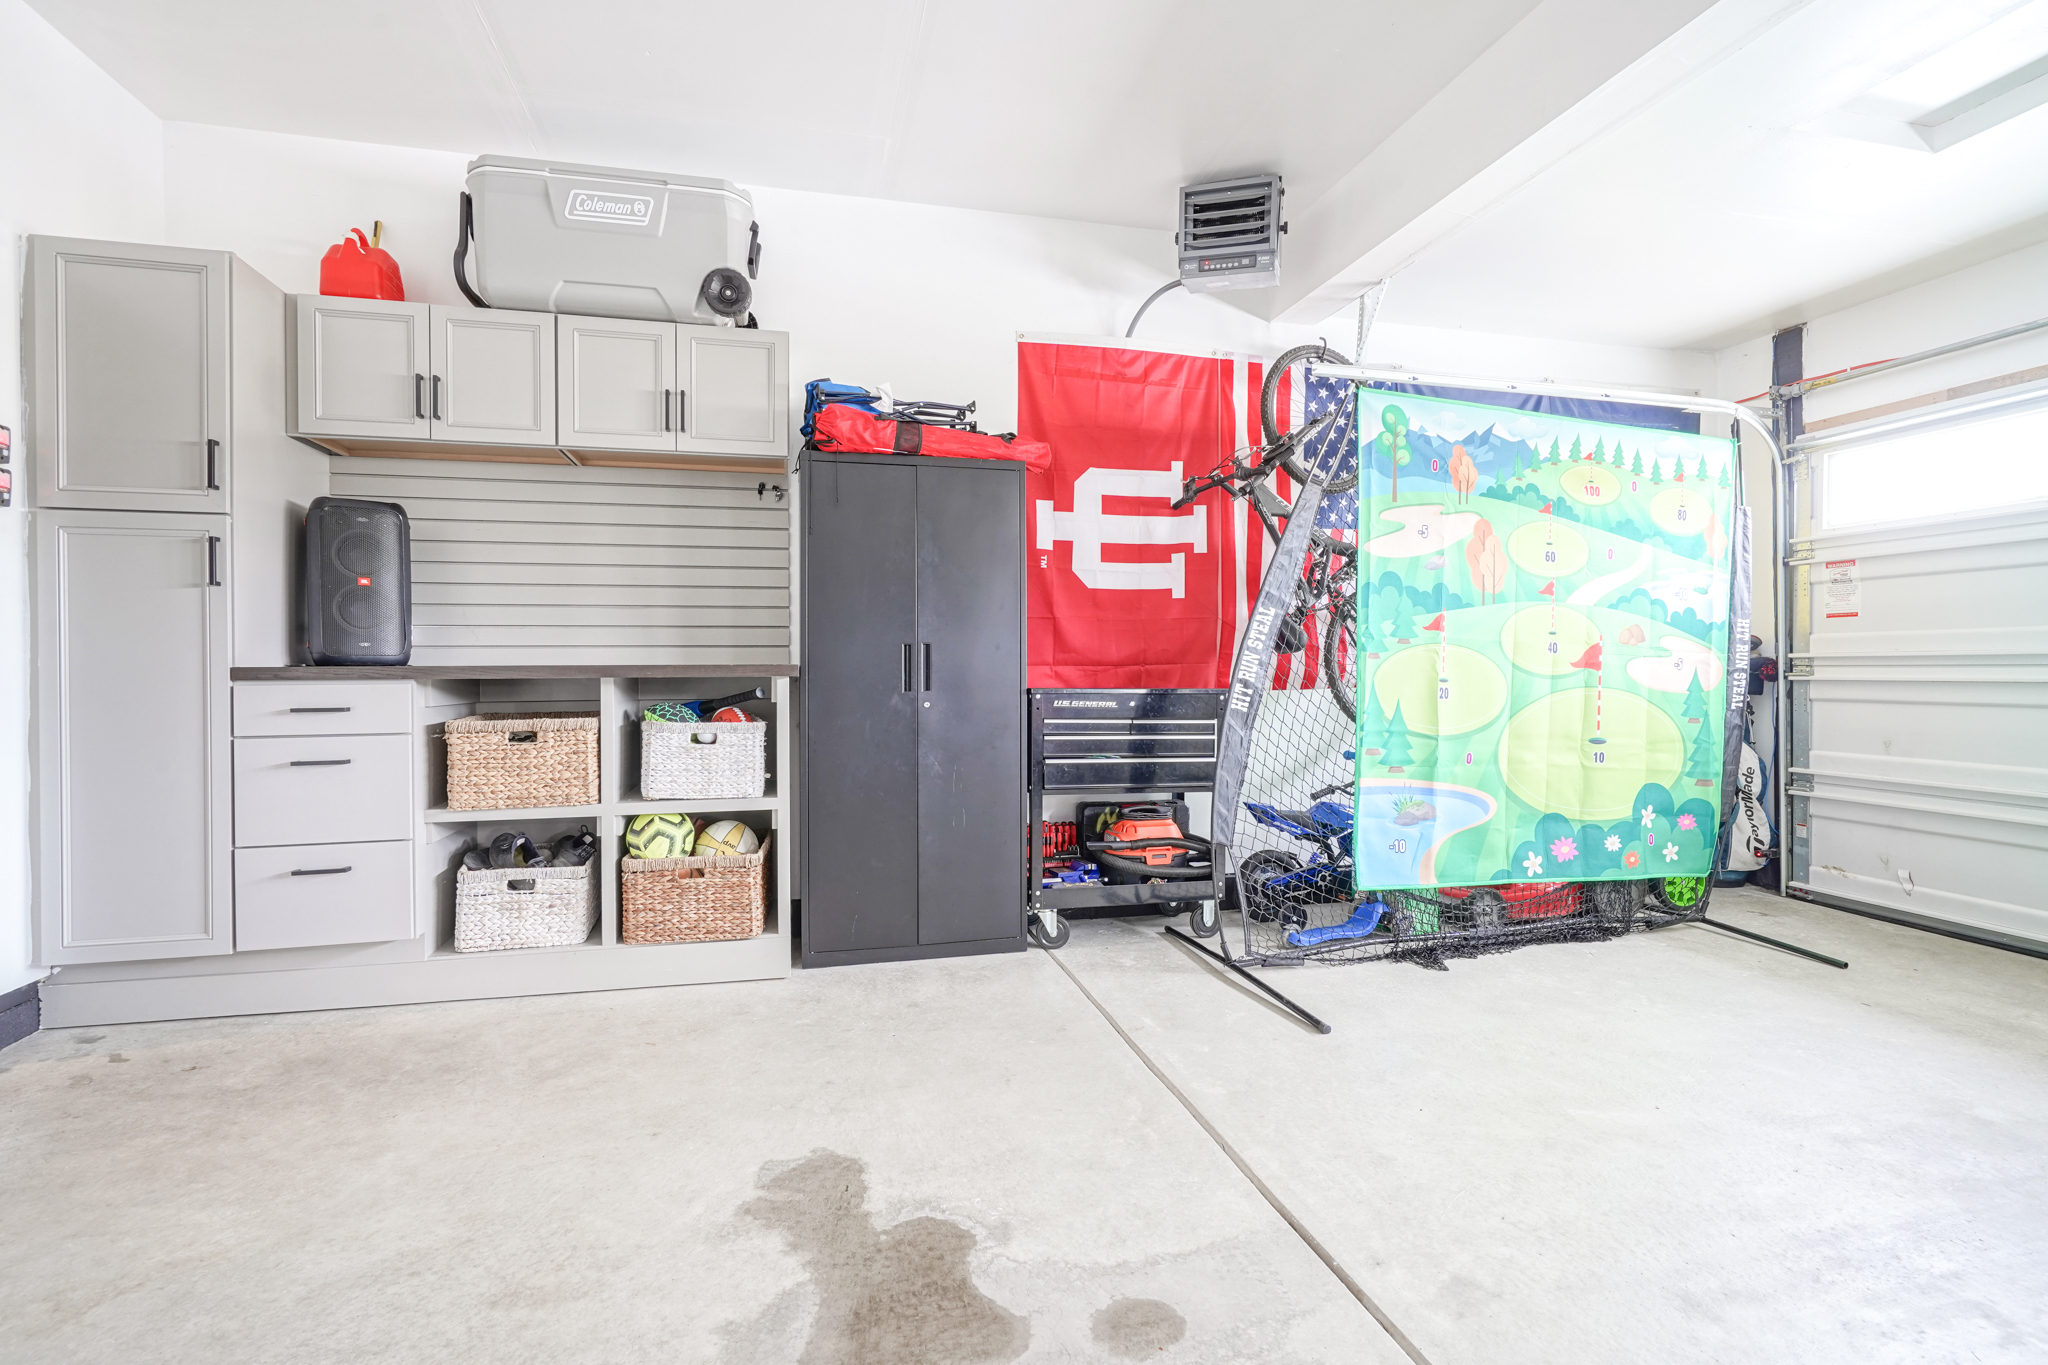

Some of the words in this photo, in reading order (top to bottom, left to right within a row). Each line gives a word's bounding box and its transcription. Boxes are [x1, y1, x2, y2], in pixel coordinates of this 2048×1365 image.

[575, 194, 632, 215] Coleman
[1584, 485, 1601, 497] 100
[1677, 509, 1687, 521] 80
[1417, 524, 1429, 539] -5
[1545, 550, 1556, 563] 60
[1247, 606, 1276, 650] STEAL
[1736, 618, 1750, 641] HIT
[1547, 642, 1558, 654] 40
[1735, 643, 1749, 669] RUN
[1238, 650, 1261, 683] RUN
[1231, 682, 1254, 713] HIT
[1439, 687, 1449, 700] 20
[1730, 672, 1747, 710] STEAL
[1071, 700, 1118, 708] GENERAL
[1593, 751, 1605, 764] 10
[1388, 838, 1407, 854] -10
